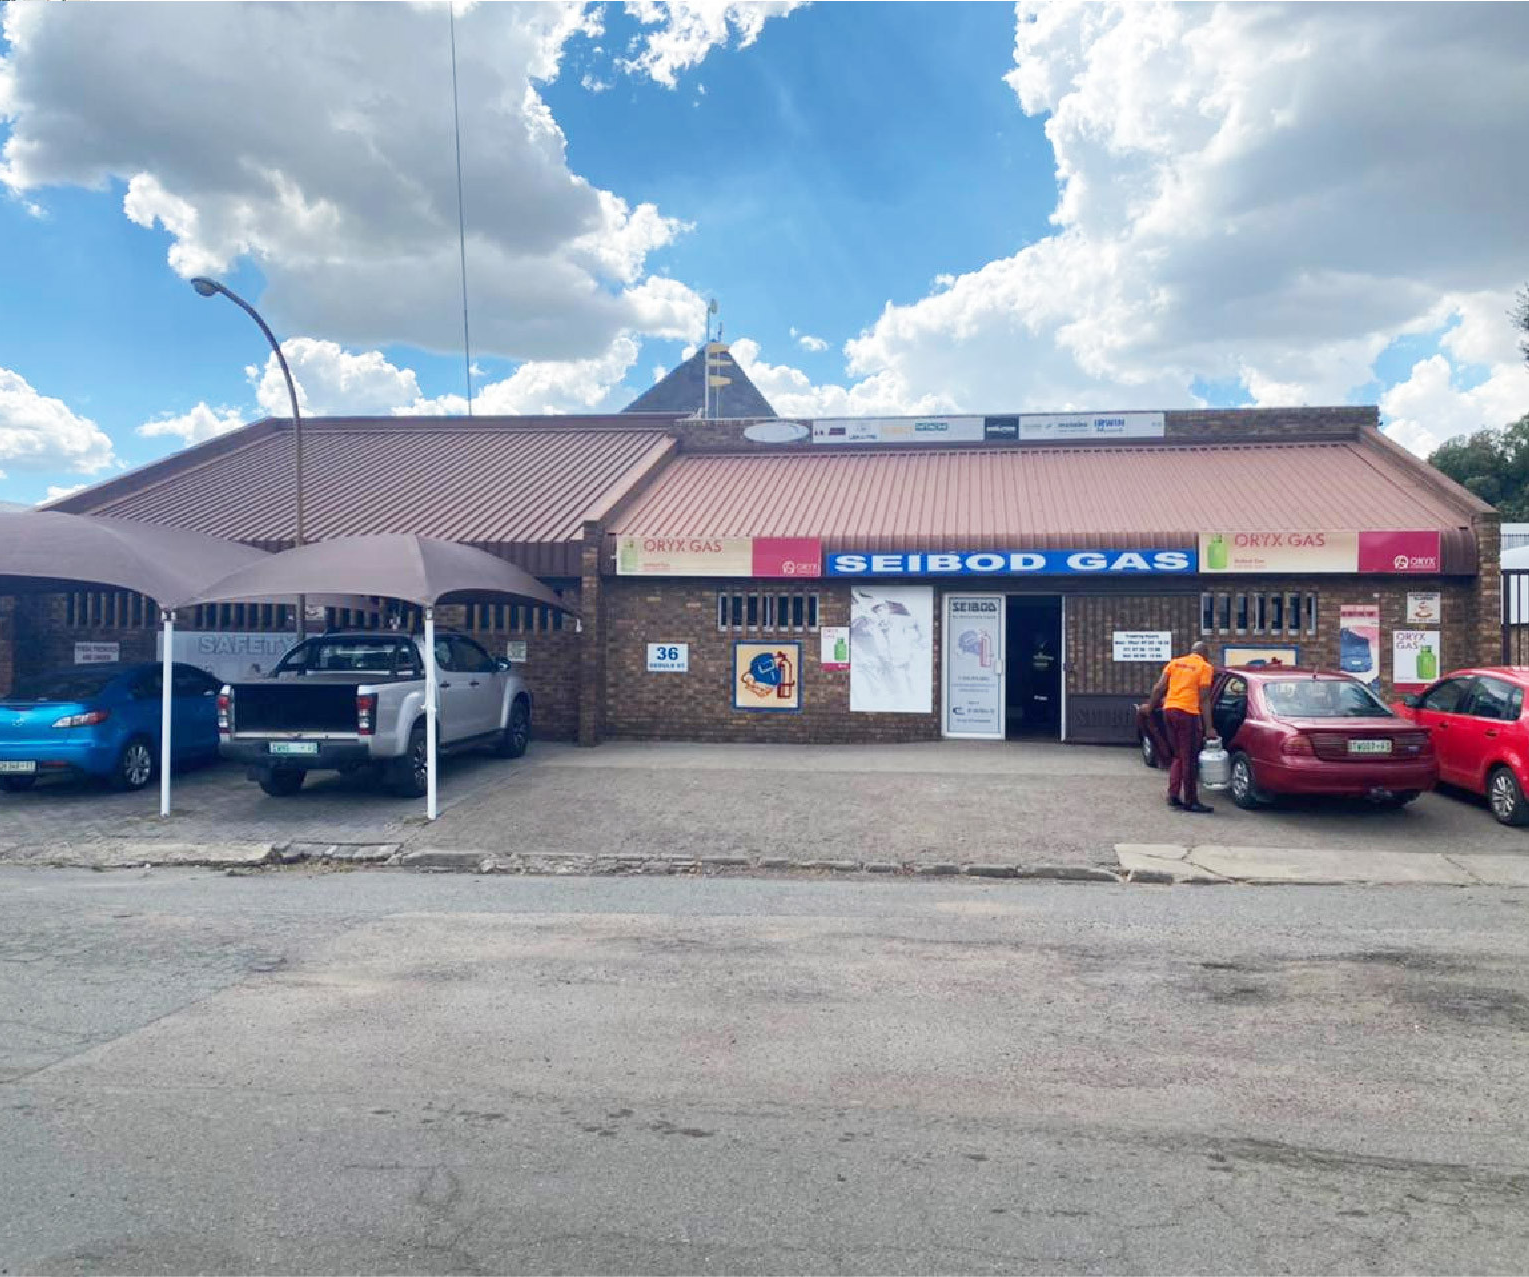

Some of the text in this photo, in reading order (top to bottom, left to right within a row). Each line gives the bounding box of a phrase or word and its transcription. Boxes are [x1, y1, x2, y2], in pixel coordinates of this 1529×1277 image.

[643, 539, 722, 553] ORYX GAS
[1234, 532, 1325, 548] ORYX GAS
[833, 551, 1190, 573] SEIBOD GAS
[952, 602, 998, 613] SEIBOD
[1395, 632, 1426, 641] ORYX
[1395, 642, 1419, 650] GAS
[656, 646, 679, 661] 36
